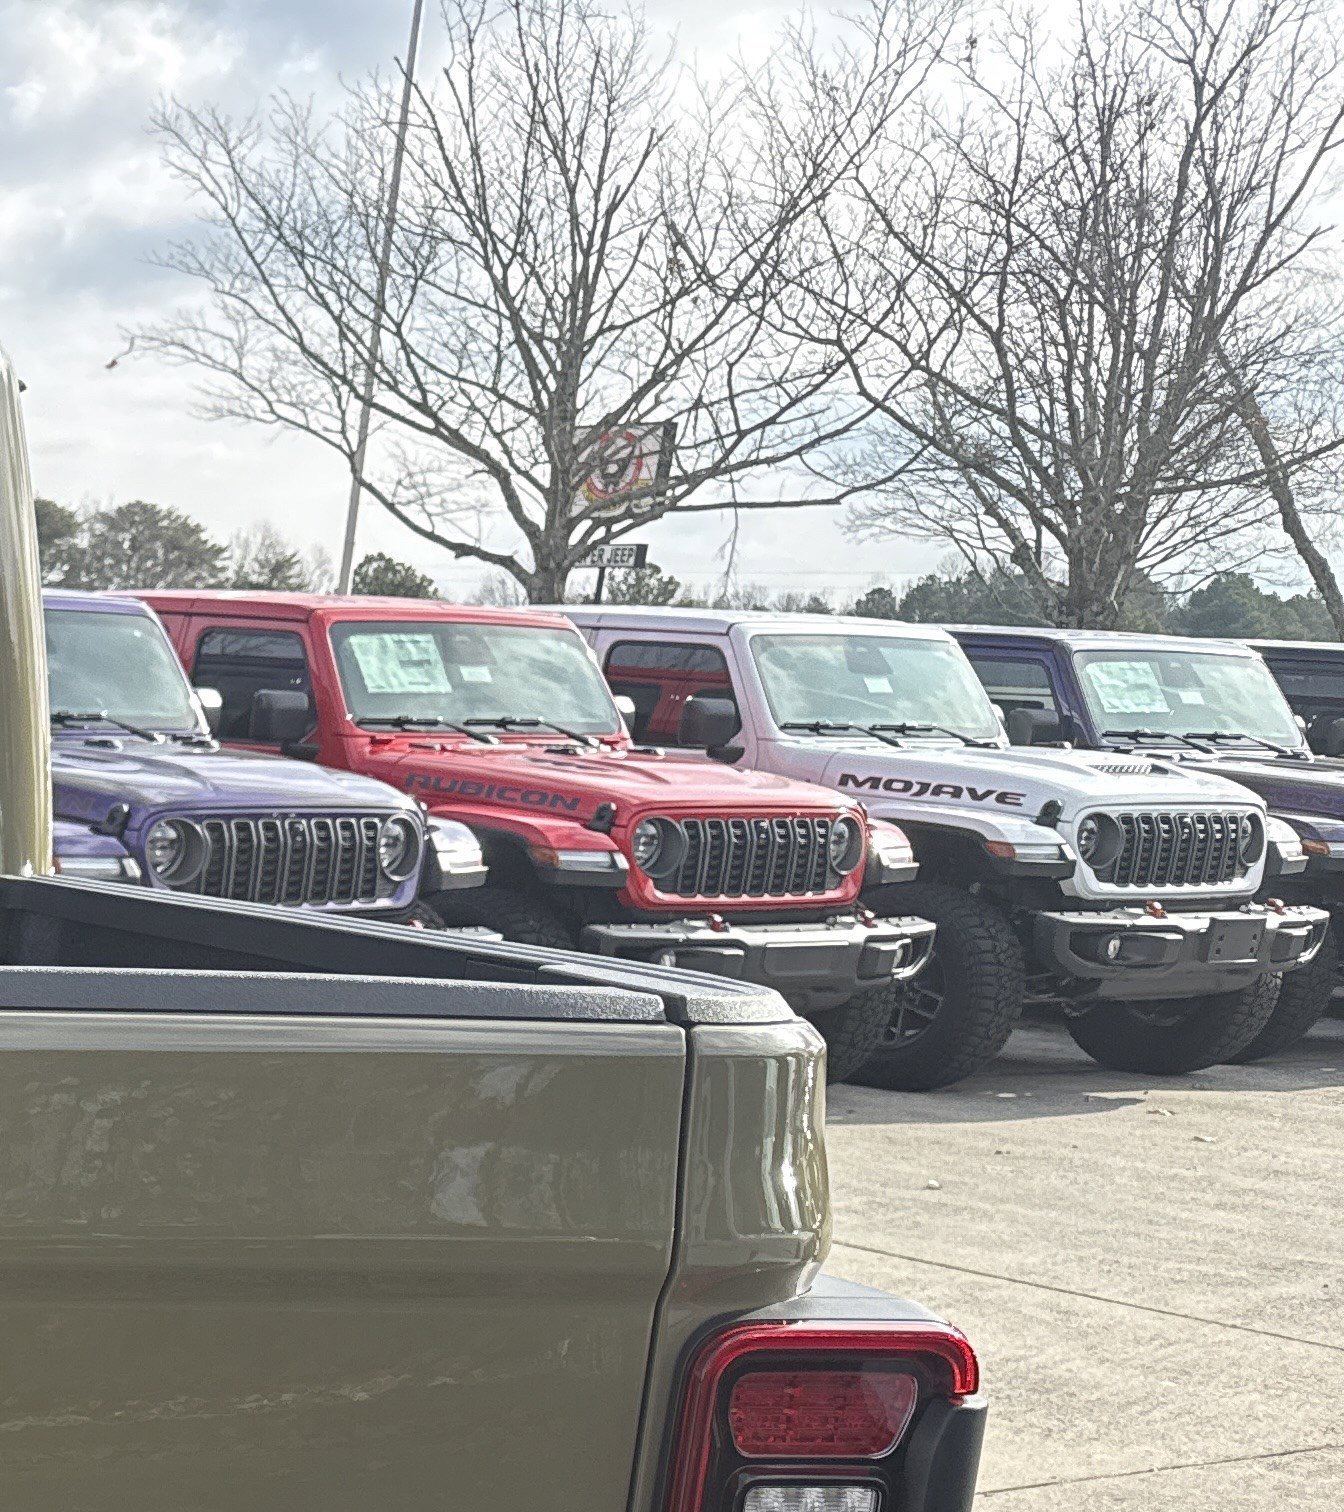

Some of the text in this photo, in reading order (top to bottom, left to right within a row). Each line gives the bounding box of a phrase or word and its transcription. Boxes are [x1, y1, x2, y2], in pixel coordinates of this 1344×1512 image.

[607, 547, 634, 563] JEEP
[405, 771, 580, 811] RUBICON
[838, 773, 1026, 807] MOJAVE
